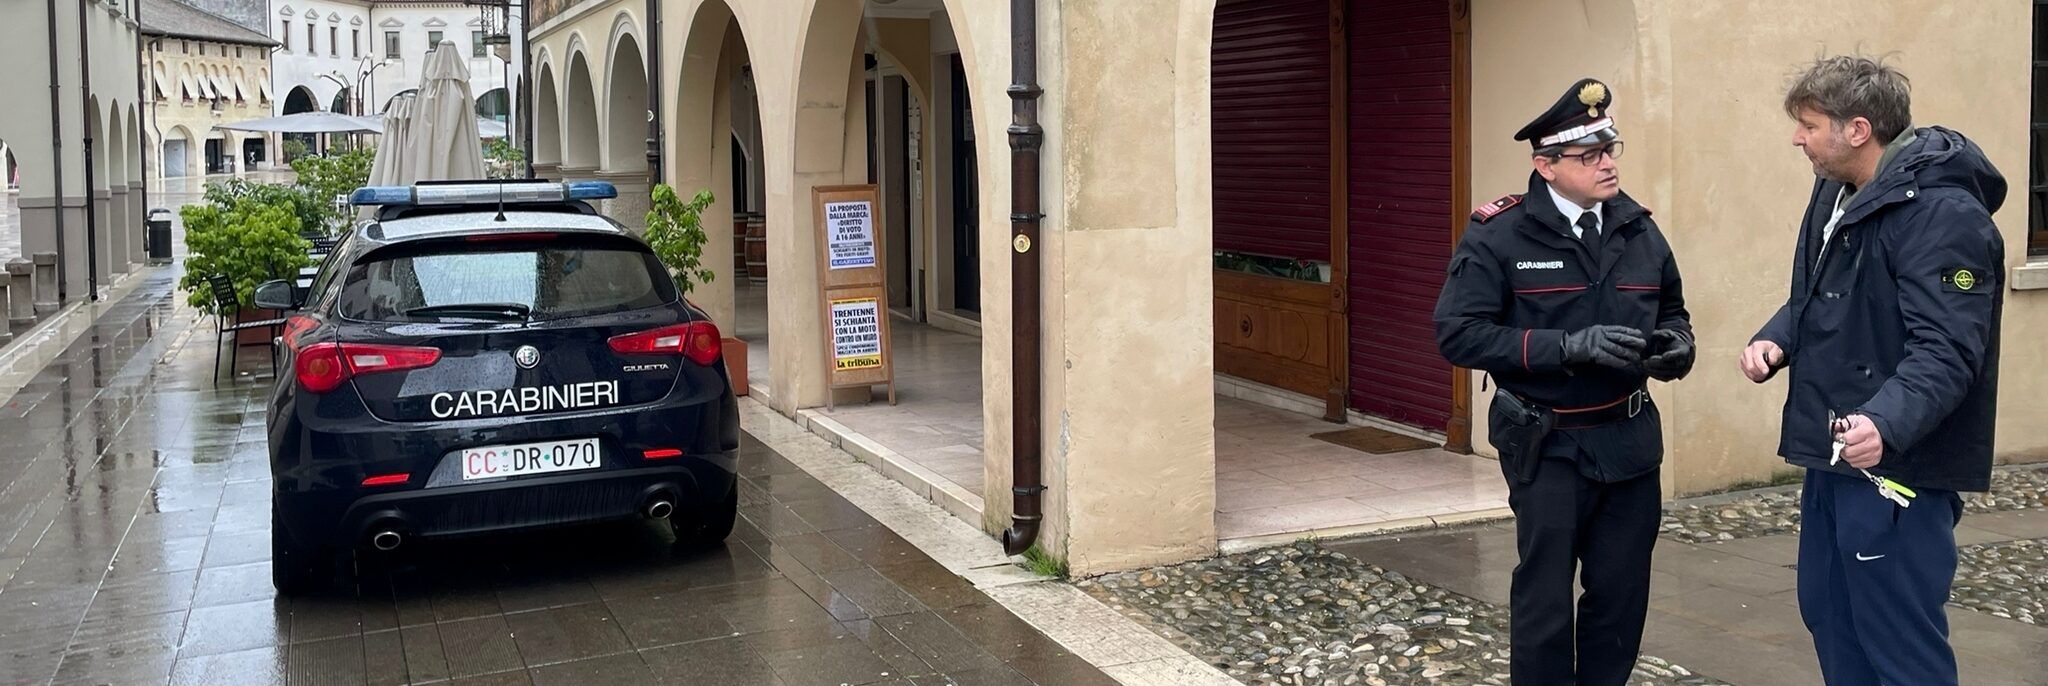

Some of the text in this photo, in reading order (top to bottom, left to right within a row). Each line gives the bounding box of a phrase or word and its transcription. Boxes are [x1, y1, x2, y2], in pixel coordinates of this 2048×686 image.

[838, 204, 867, 212] PROPOSTA
[1516, 260, 1564, 270] CARABINIERI
[834, 308, 874, 318] TRENTENNE
[842, 316, 876, 326] SCHIANTA
[858, 325, 876, 333] MOTO
[836, 335, 854, 344] CONTRO
[847, 358, 880, 367] tribuna
[623, 364, 669, 372] GIULIETTA
[430, 380, 619, 418] CARABINIERI
[468, 442, 596, 476] CC DR 070
